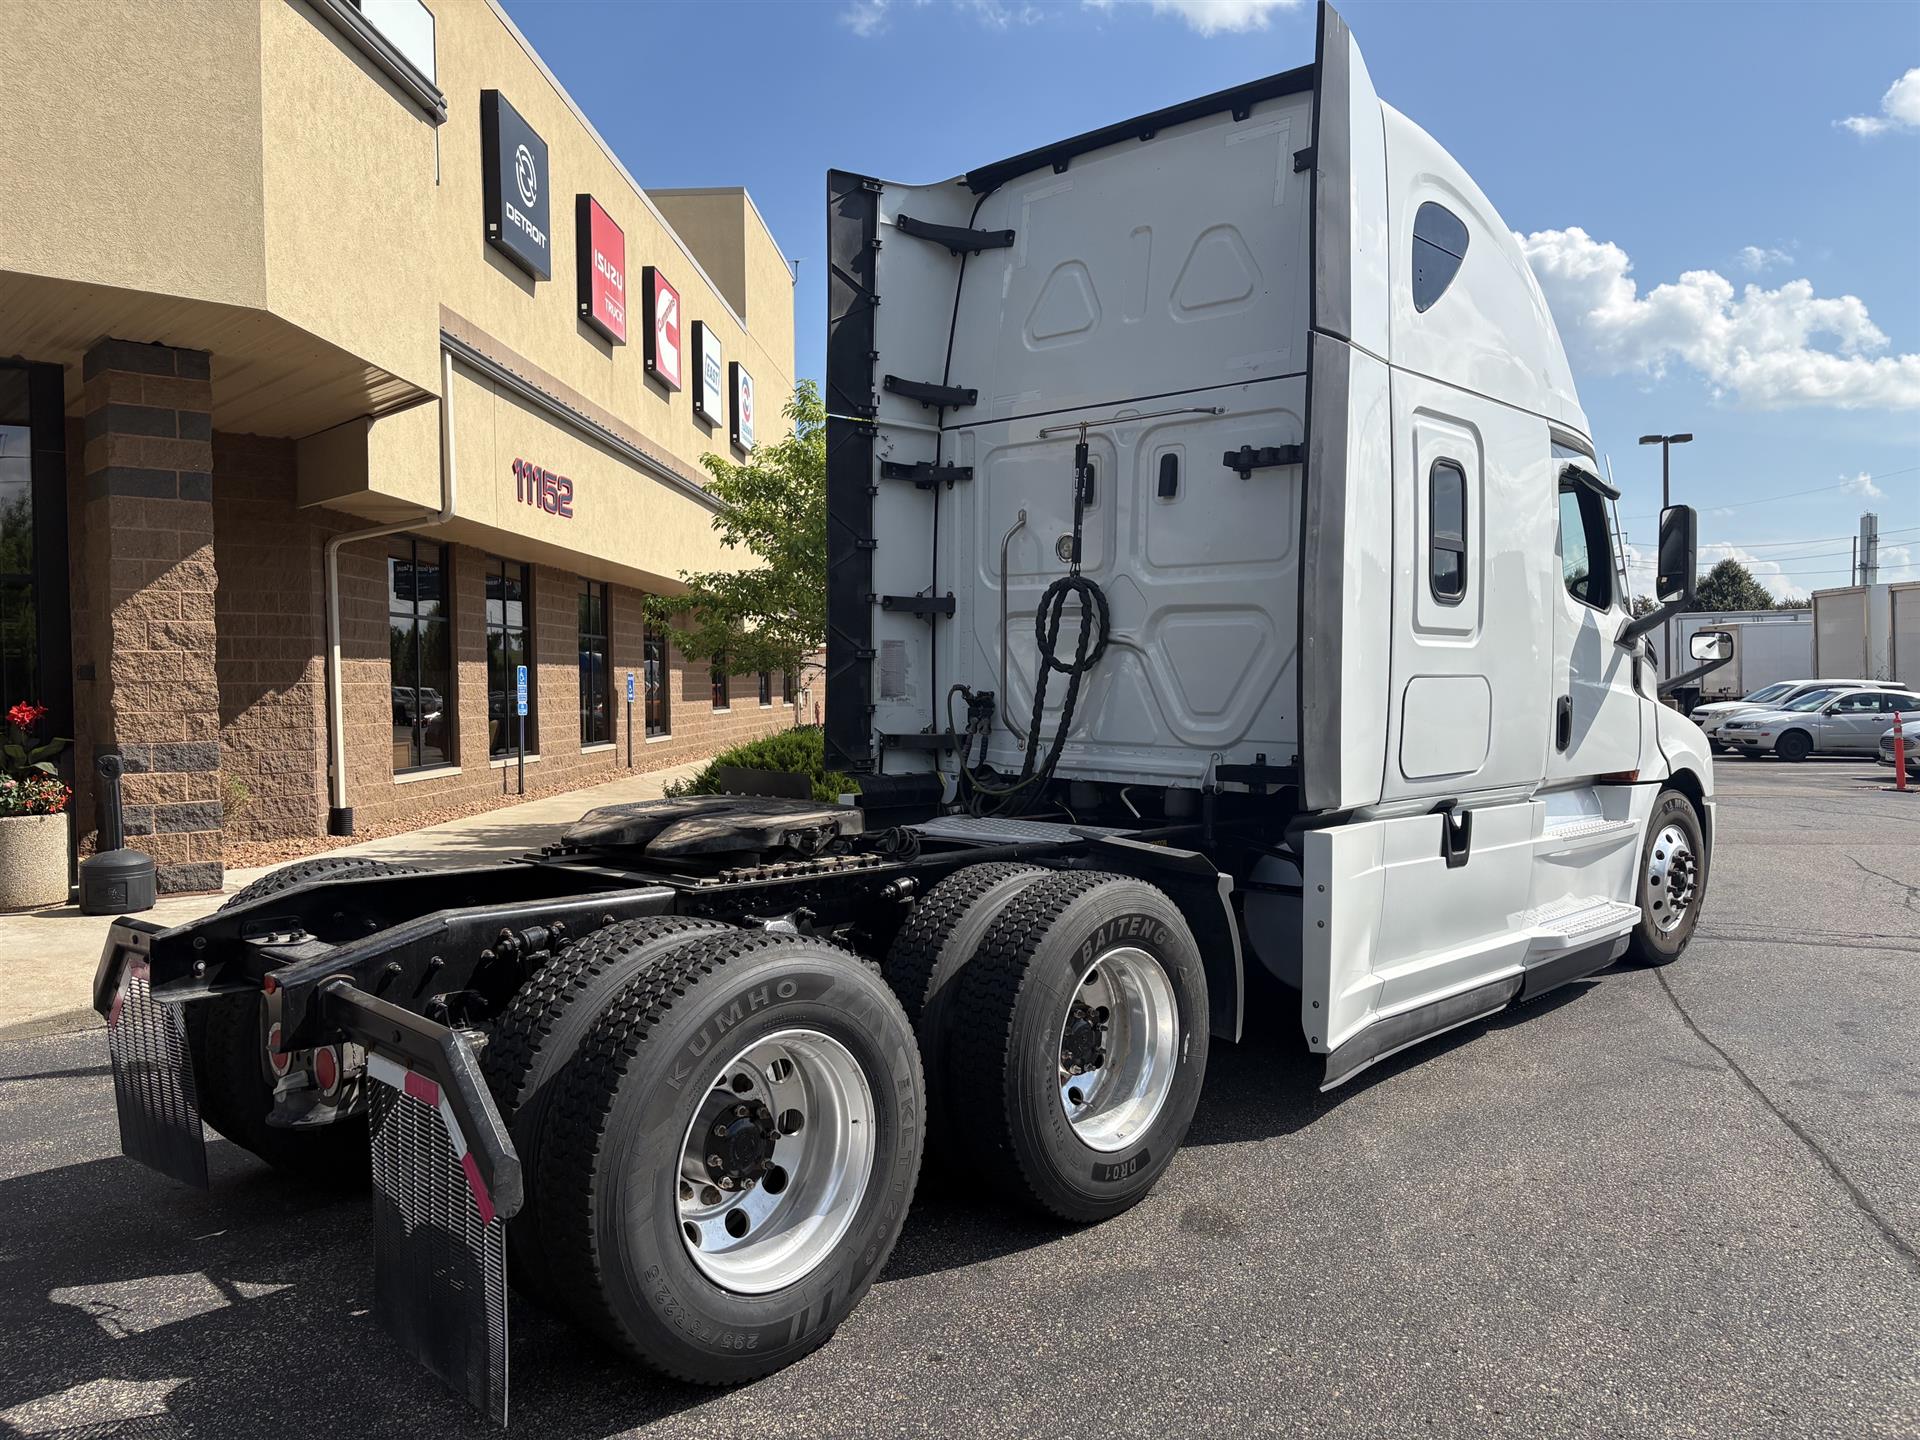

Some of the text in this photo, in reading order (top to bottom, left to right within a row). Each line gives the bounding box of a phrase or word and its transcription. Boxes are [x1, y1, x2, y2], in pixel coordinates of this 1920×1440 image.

[505, 201, 547, 249] DETROIT
[594, 249, 623, 291] ISUZU
[604, 297, 624, 325] TRUCK
[511, 457, 574, 519] 11152
[1082, 916, 1167, 966] BAITENG
[665, 980, 798, 1091] KUMHO
[1105, 1158, 1136, 1181] DR01
